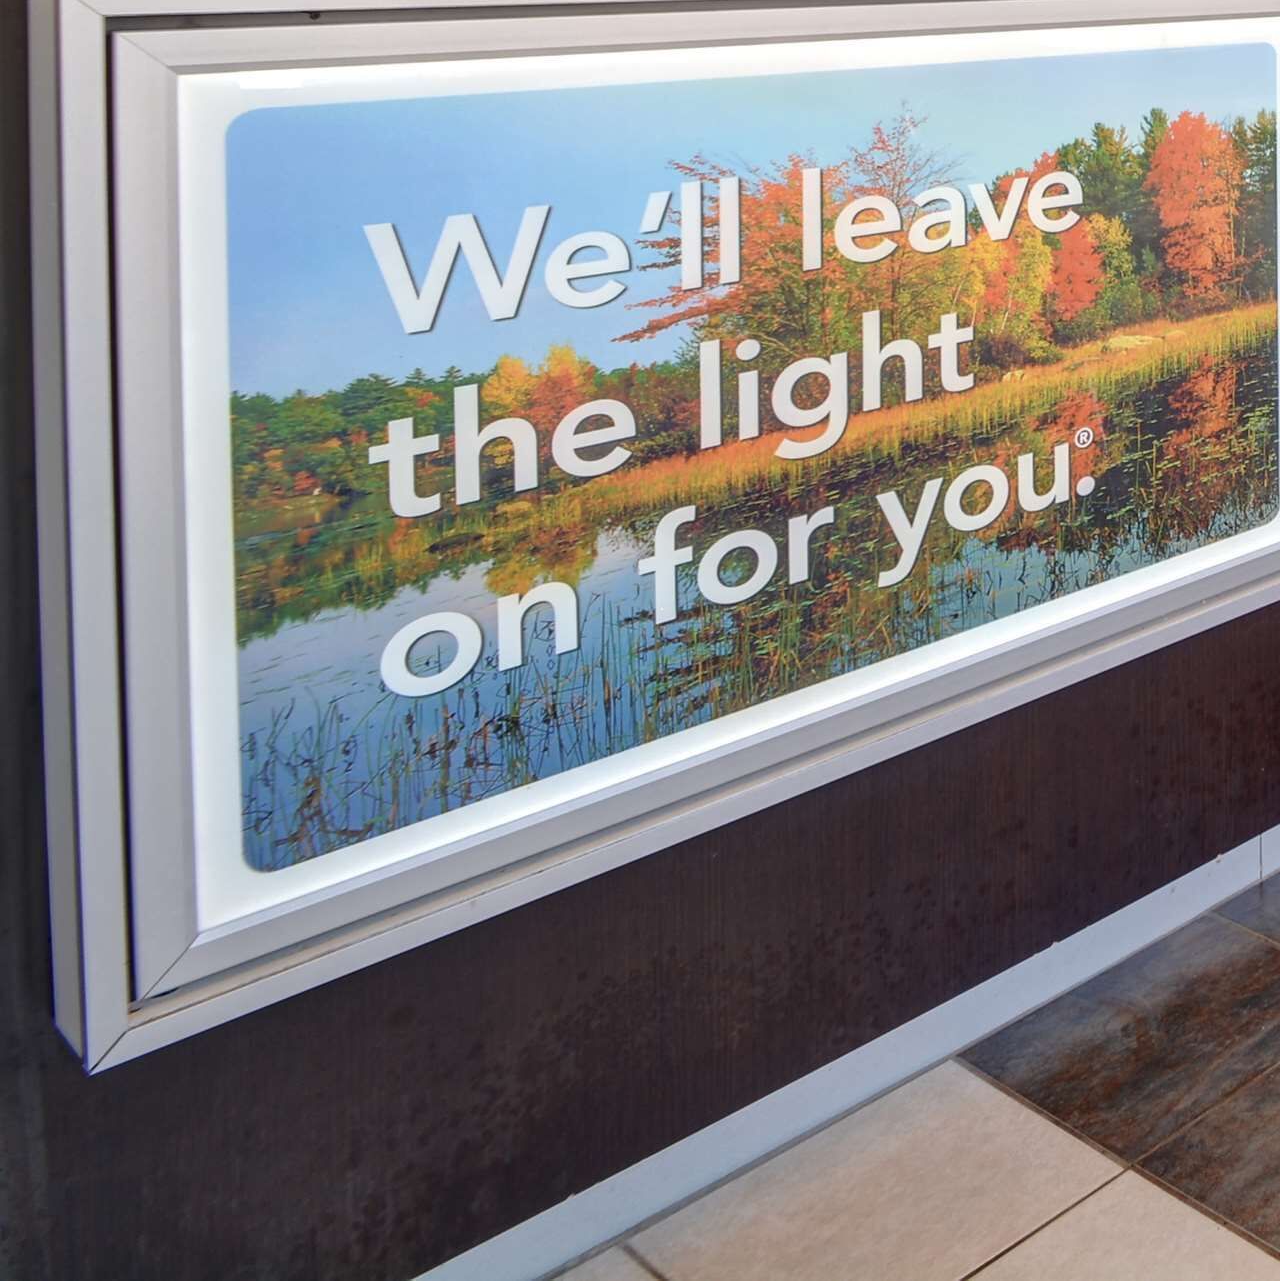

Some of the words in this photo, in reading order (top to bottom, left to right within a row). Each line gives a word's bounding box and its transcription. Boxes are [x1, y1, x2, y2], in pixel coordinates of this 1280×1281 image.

[364, 177, 742, 336] We'll
[800, 166, 1083, 275] leave
[369, 385, 634, 521] the
[699, 307, 978, 463] light
[380, 579, 578, 700] on
[638, 502, 834, 627] for
